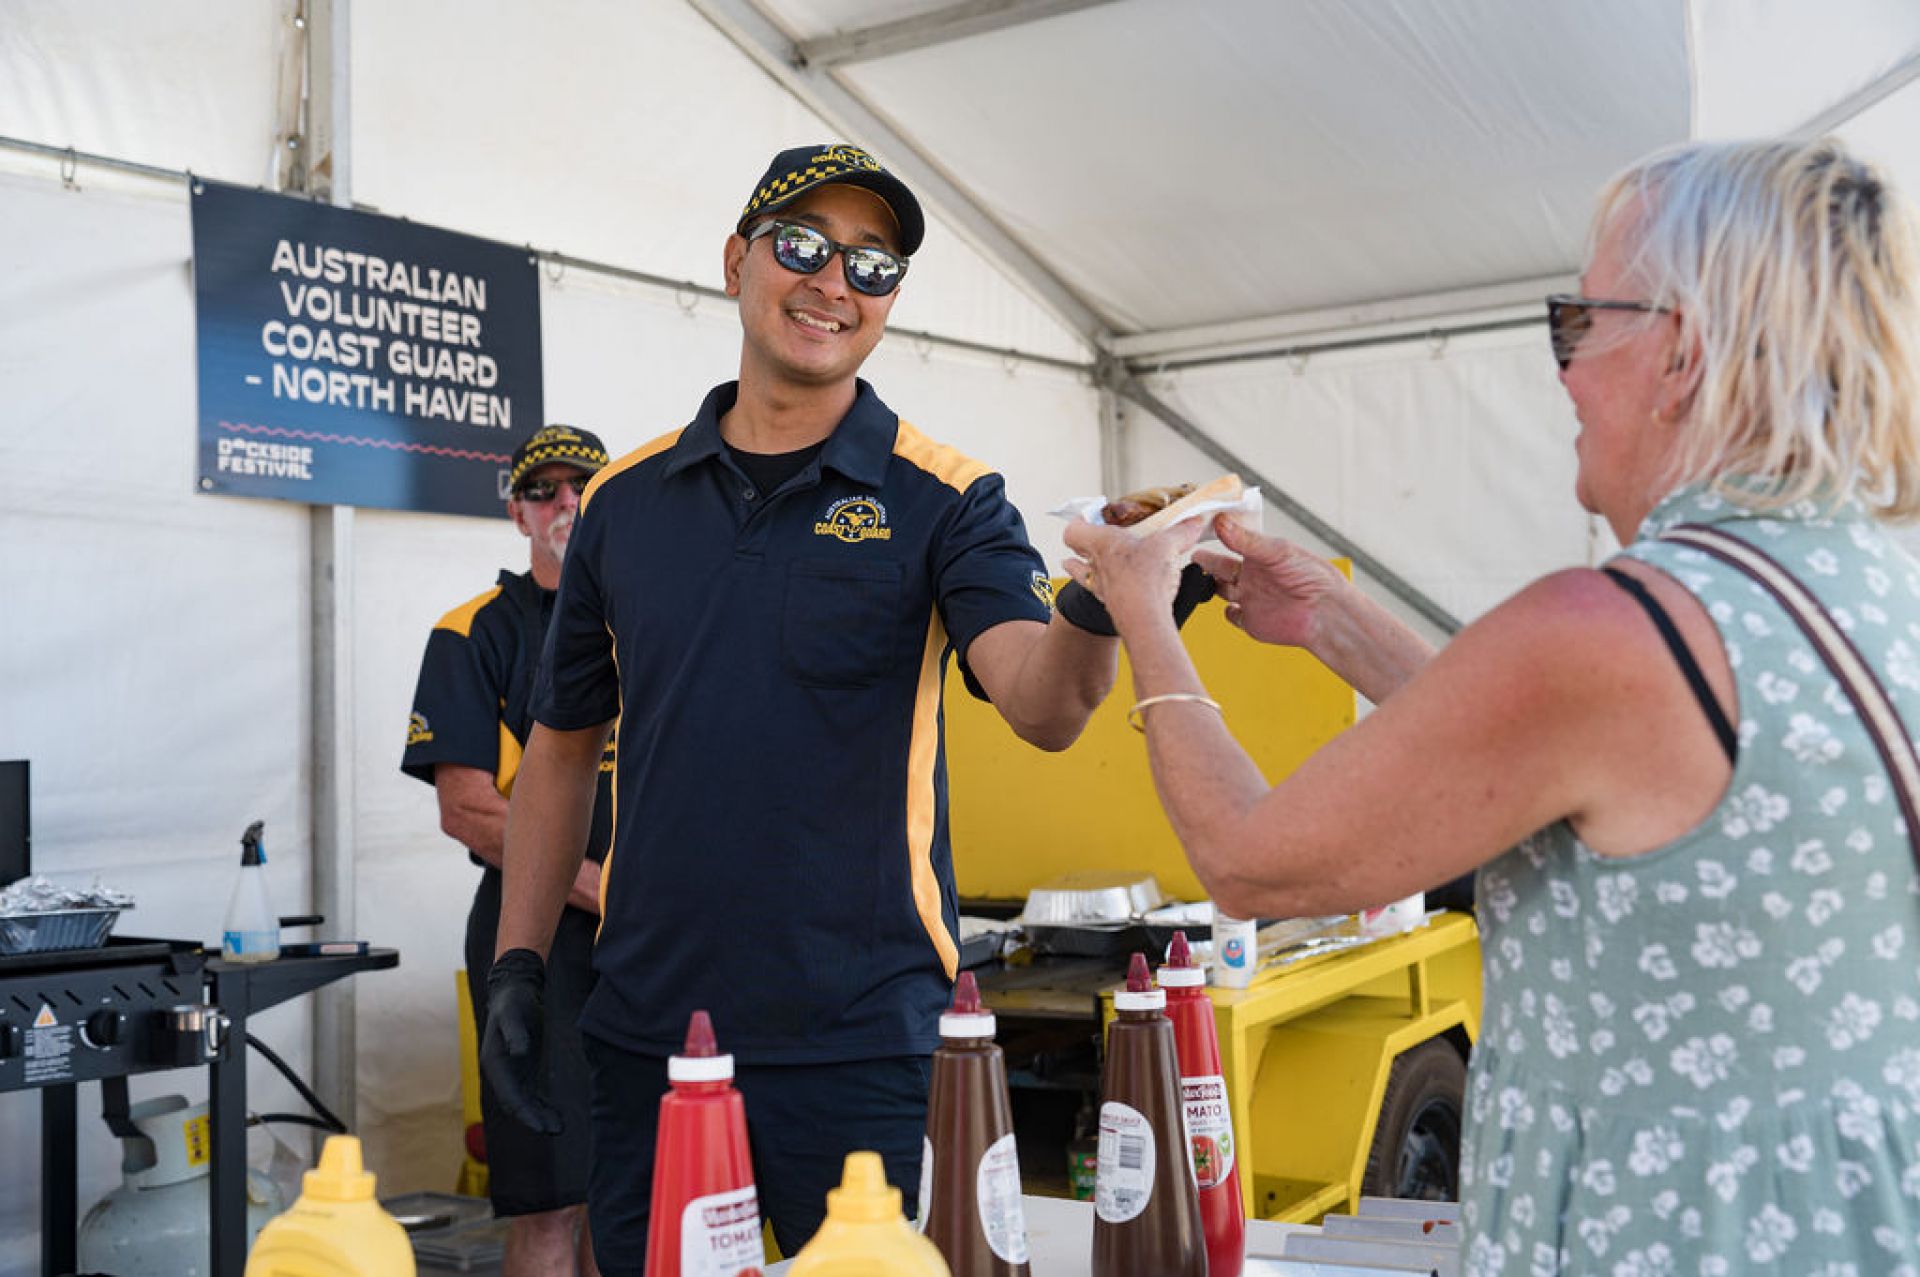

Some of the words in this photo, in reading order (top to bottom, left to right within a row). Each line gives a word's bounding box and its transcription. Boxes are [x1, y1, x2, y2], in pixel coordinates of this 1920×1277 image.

[271, 239, 486, 311] AUSTRALIAN
[281, 281, 481, 347] VOLUNTEER
[262, 321, 381, 369] COAST
[388, 340, 498, 388] GUARD
[273, 363, 395, 412] NORTH
[405, 383, 511, 429] HAVEN
[218, 454, 313, 481] FESTIVAL
[1186, 1104, 1221, 1118] MATO
